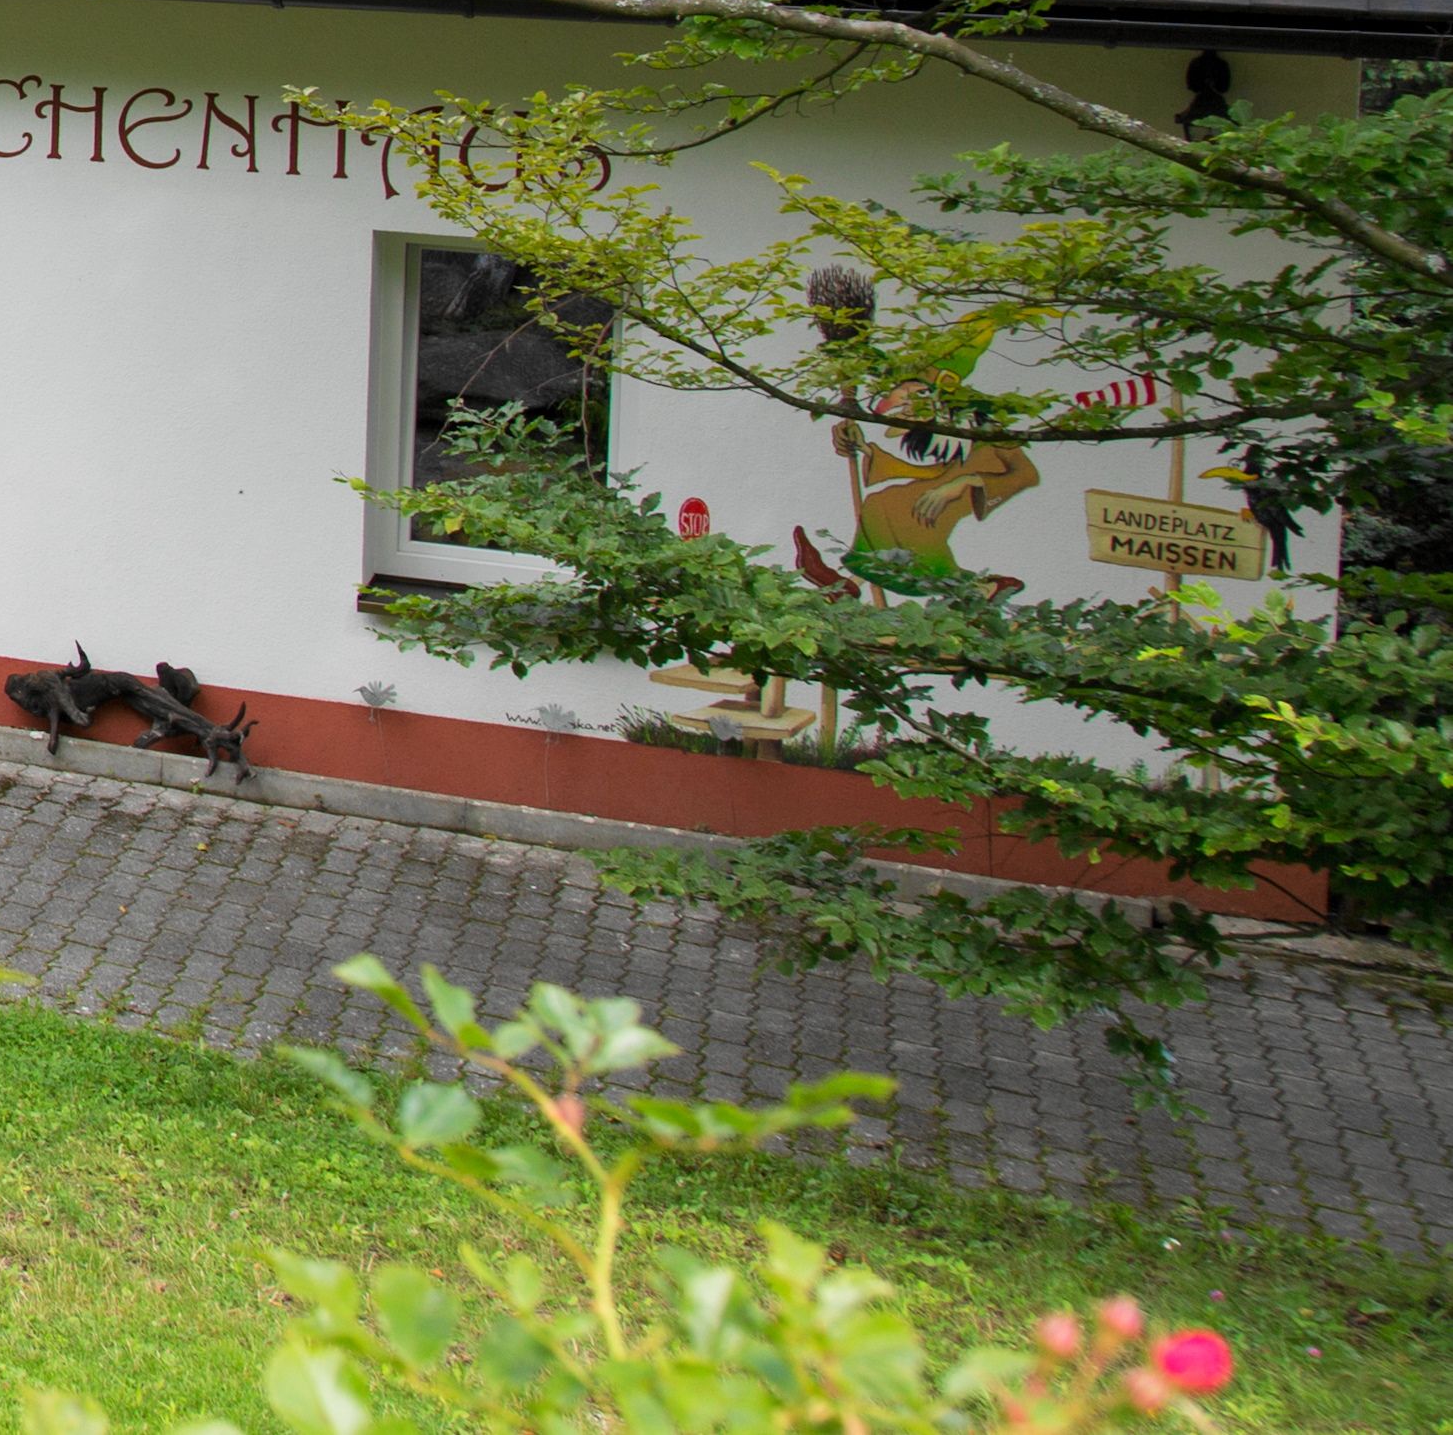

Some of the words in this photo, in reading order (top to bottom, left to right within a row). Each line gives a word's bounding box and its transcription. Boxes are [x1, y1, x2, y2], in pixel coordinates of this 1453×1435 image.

[681, 513, 709, 536] STOP
[1103, 507, 1236, 541] LANDEPLATZ
[1110, 535, 1236, 571] MAISSEN
